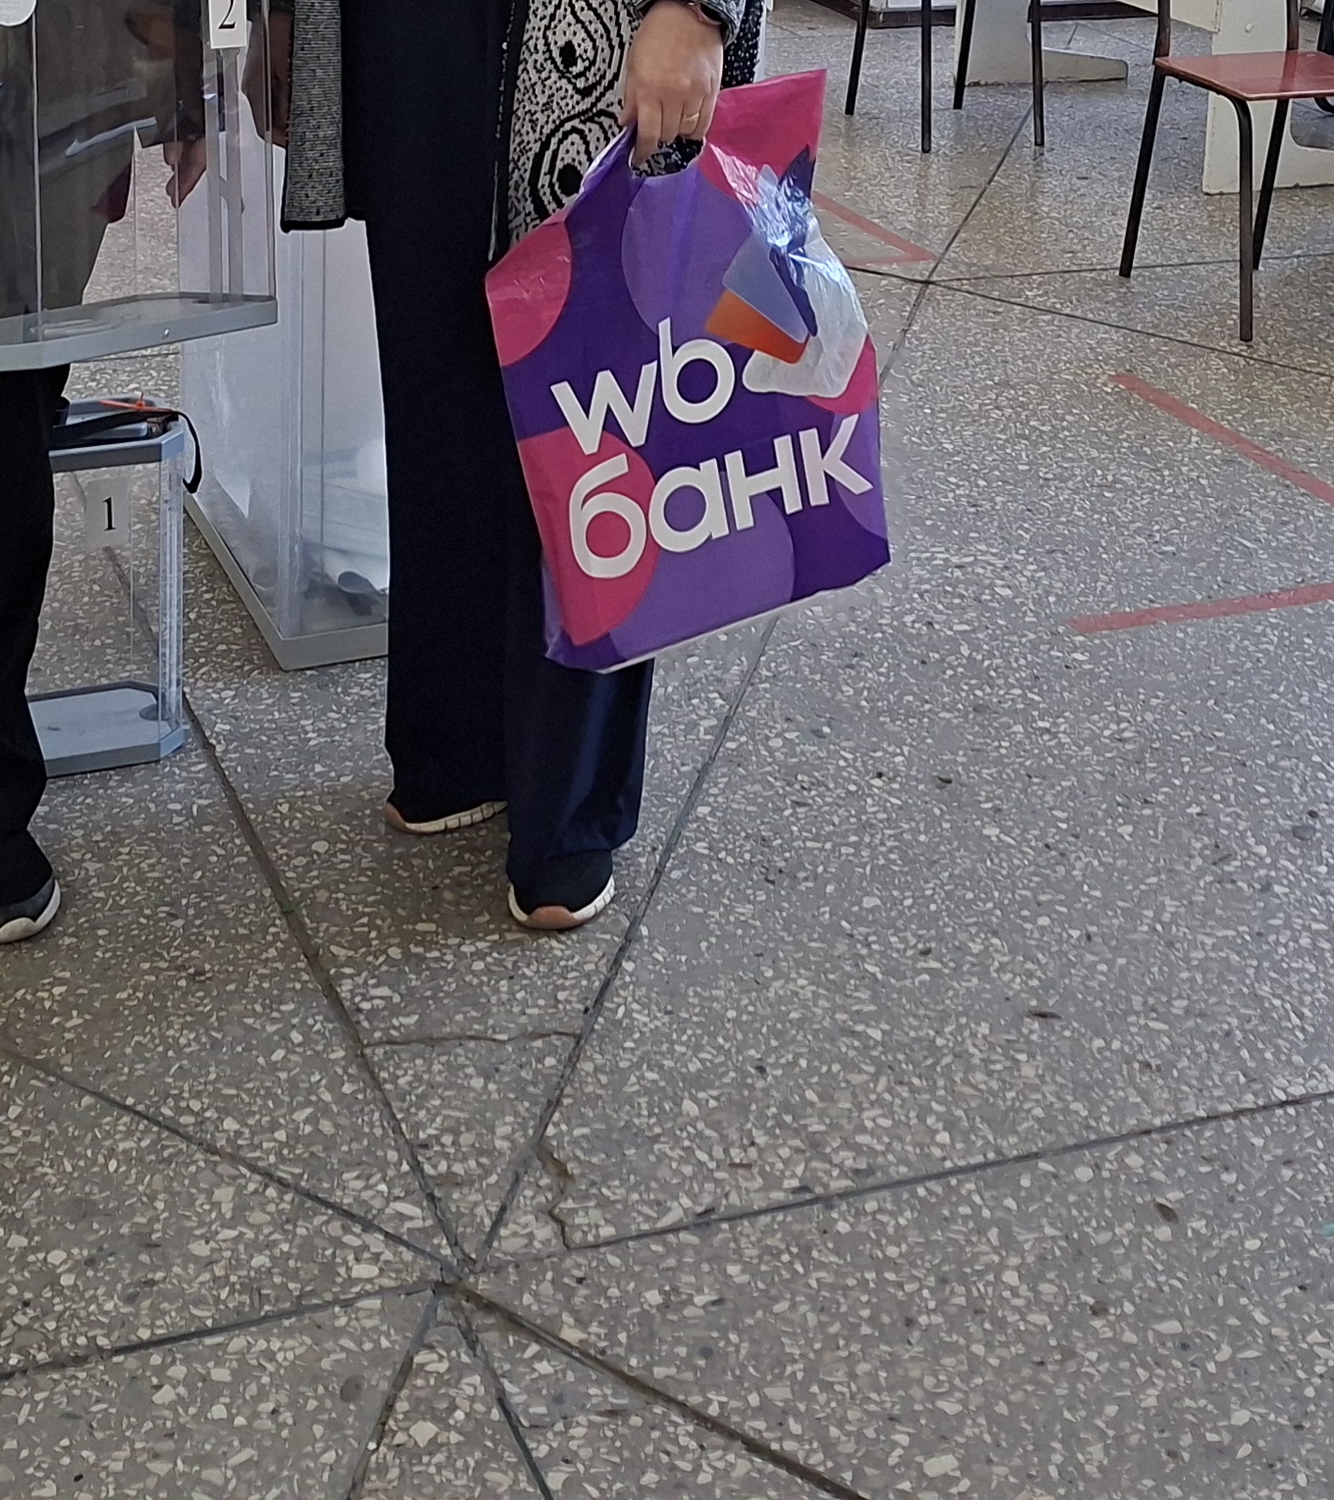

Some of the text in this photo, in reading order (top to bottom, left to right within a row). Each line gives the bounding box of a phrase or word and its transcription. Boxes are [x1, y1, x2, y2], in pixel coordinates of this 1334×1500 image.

[550, 316, 736, 456] wb
[101, 495, 118, 532] 1
[569, 413, 874, 579] банк
